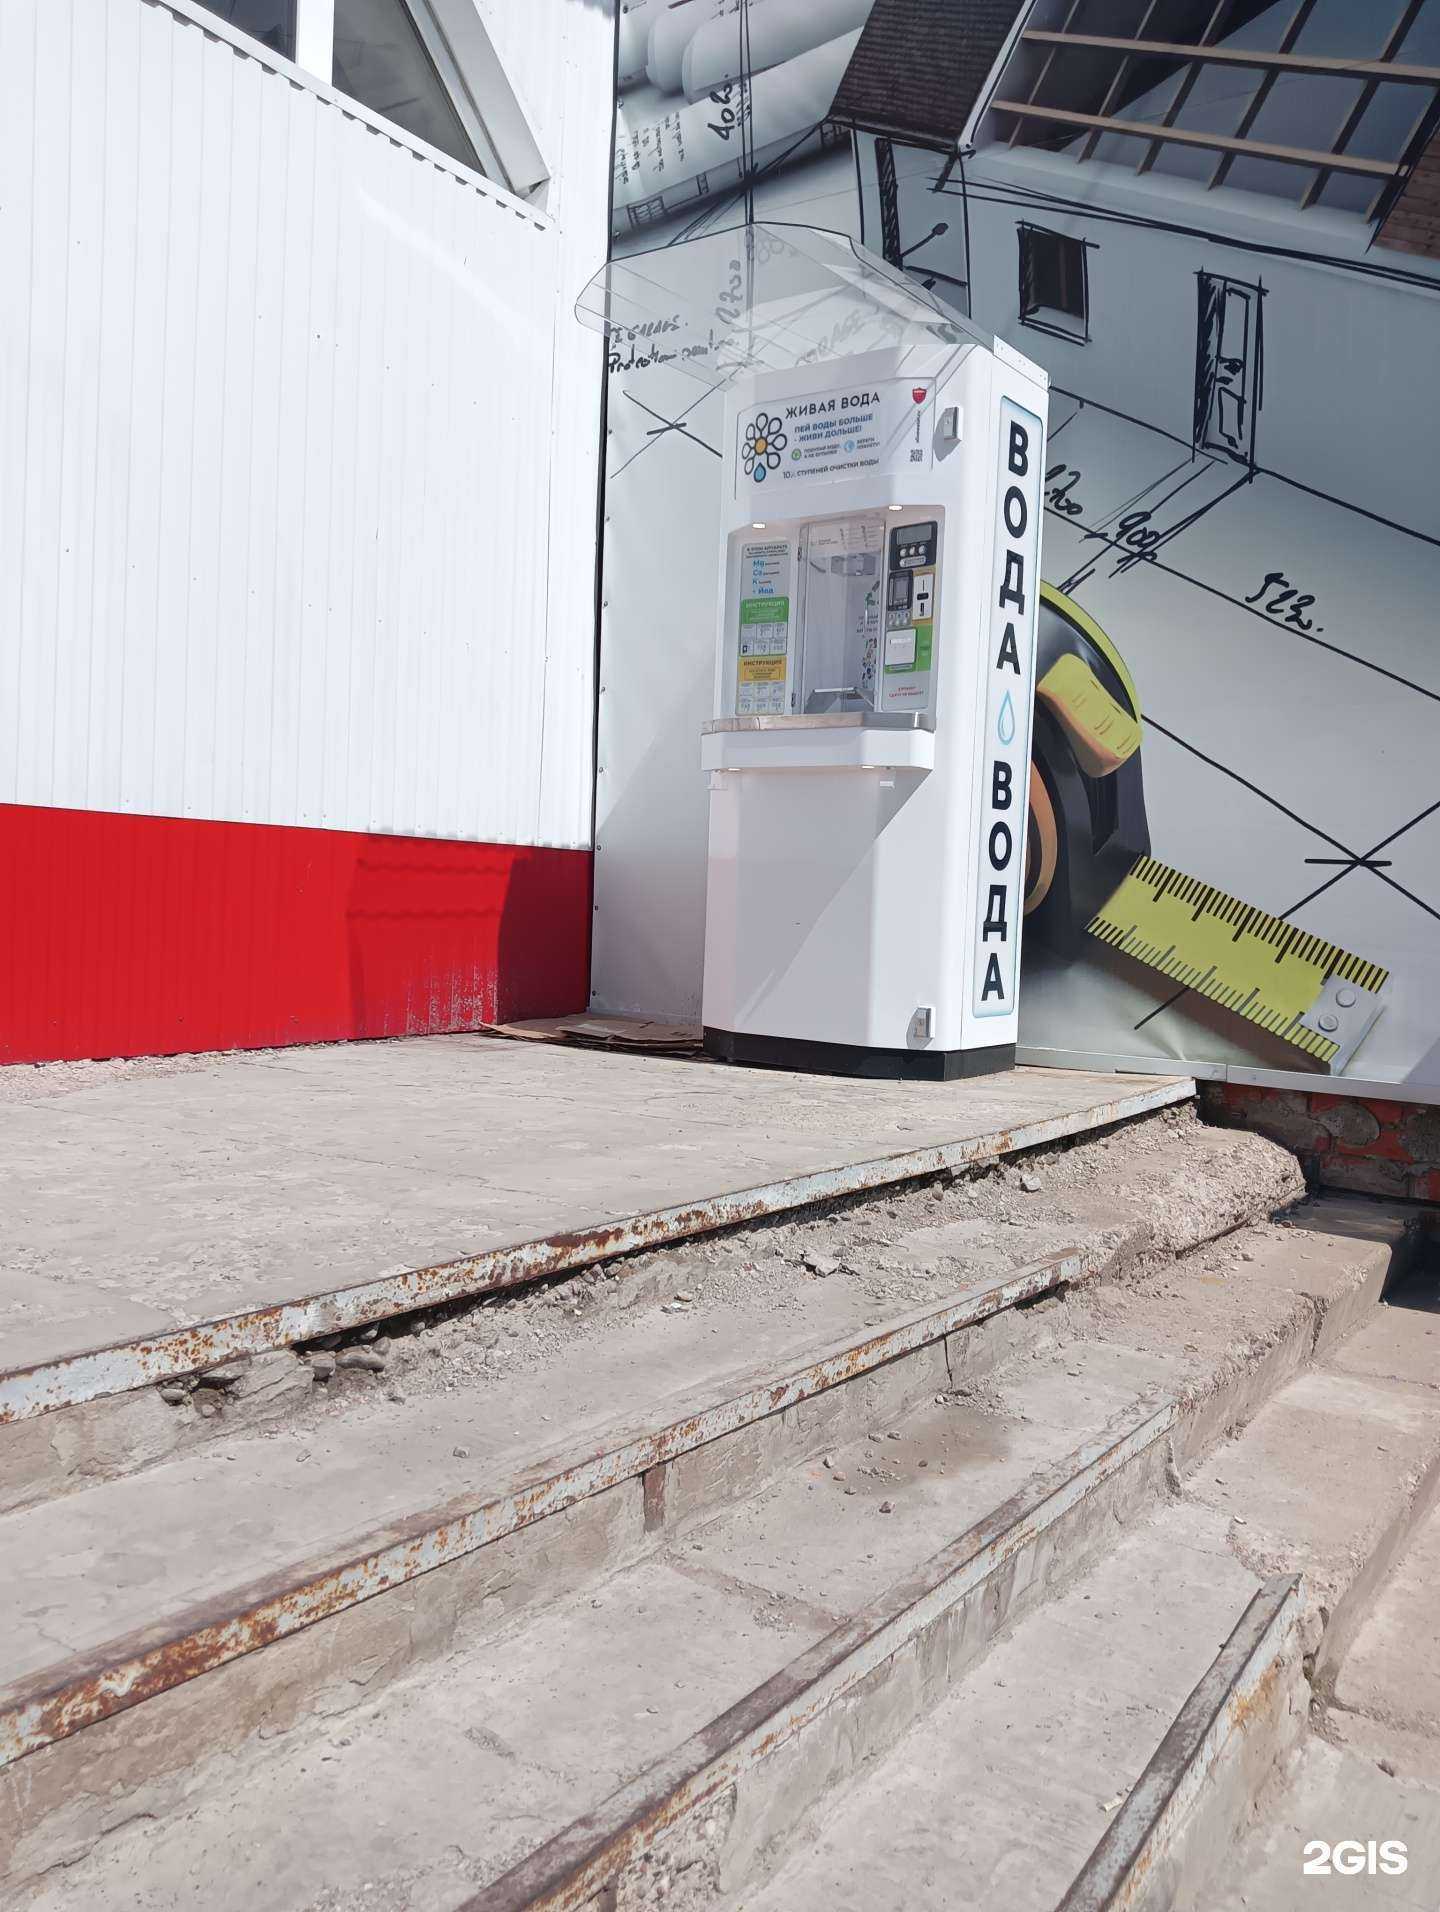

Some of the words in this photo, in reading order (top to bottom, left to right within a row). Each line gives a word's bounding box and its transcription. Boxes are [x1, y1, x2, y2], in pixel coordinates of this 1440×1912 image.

[785, 399, 836, 420] ЖИВАЯ
[841, 392, 880, 409] ВОДА
[794, 423, 811, 434] ПЕЙ
[812, 420, 837, 431] ВОДЫ
[838, 413, 874, 426] БОЛЬШЕ
[799, 431, 823, 443] ЖИВИ
[824, 424, 862, 439] ДОЛЬШЕ!
[996, 419, 1029, 675] ВОДА
[981, 760, 1014, 1002] ВОДА
